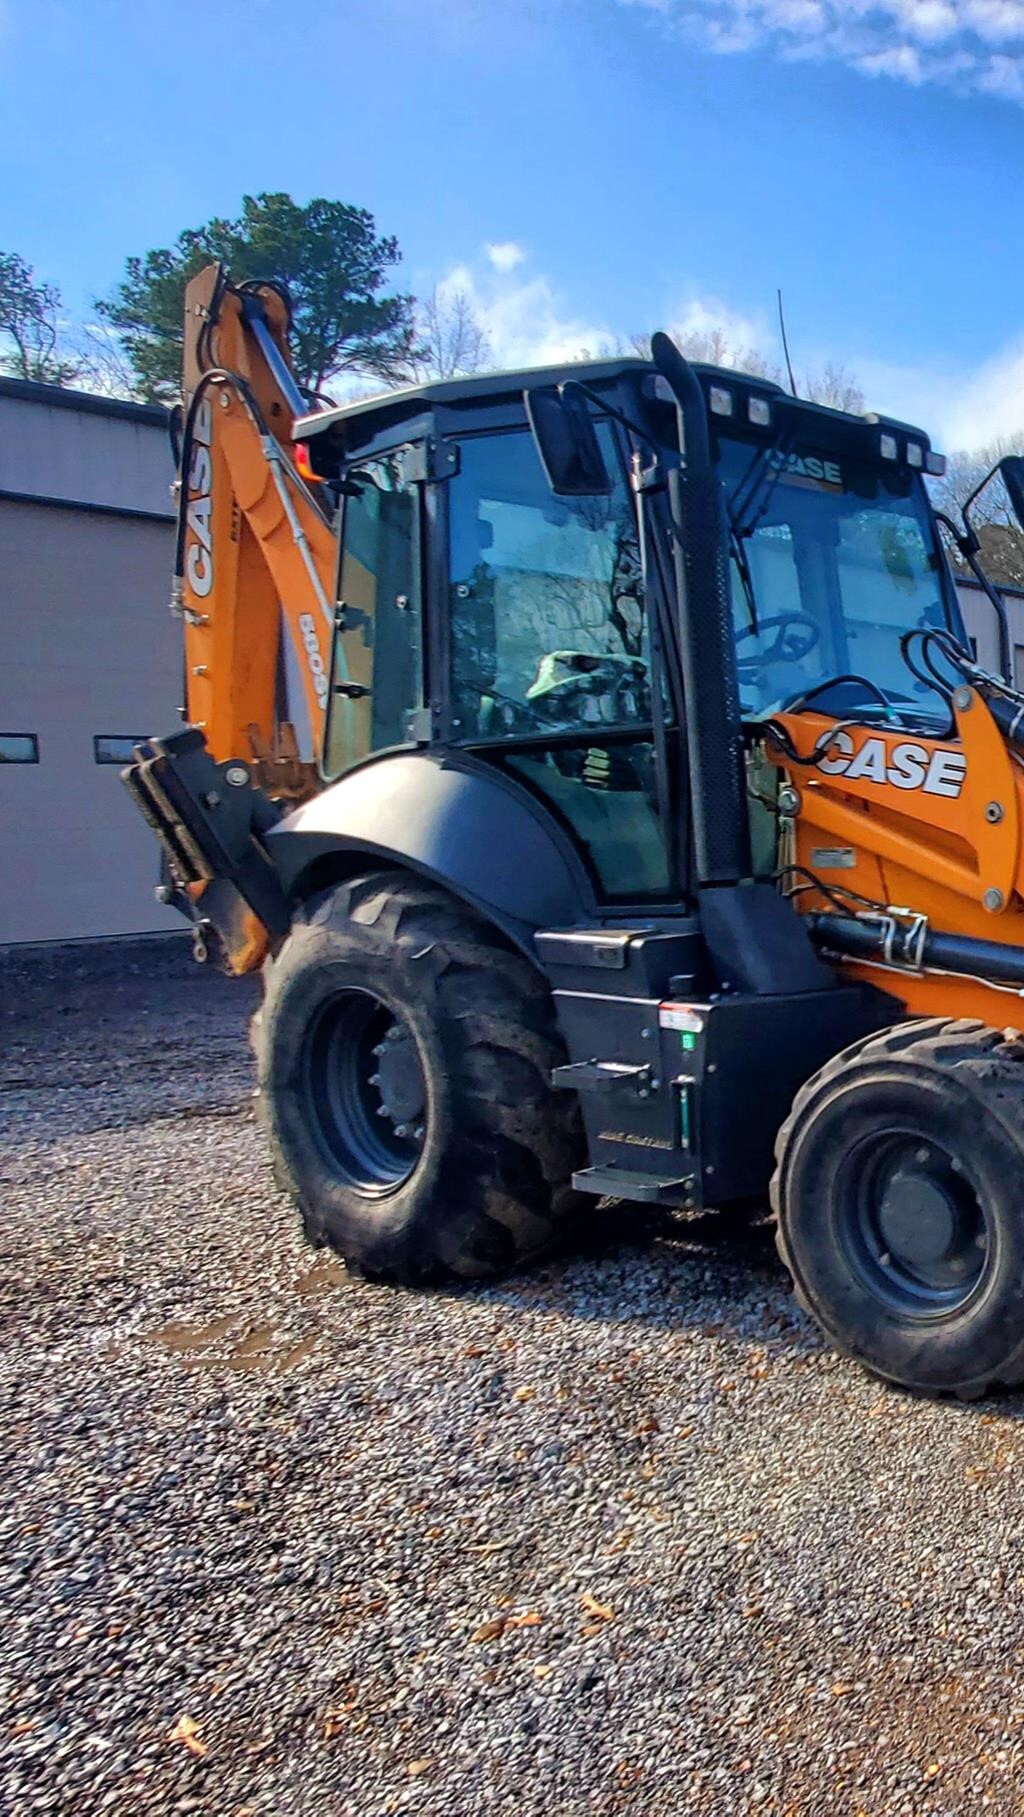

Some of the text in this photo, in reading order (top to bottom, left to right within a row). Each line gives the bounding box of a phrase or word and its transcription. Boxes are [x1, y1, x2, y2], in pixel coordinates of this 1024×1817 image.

[187, 397, 213, 597] CASE
[763, 448, 842, 484] CASE
[815, 730, 967, 798] CASE
